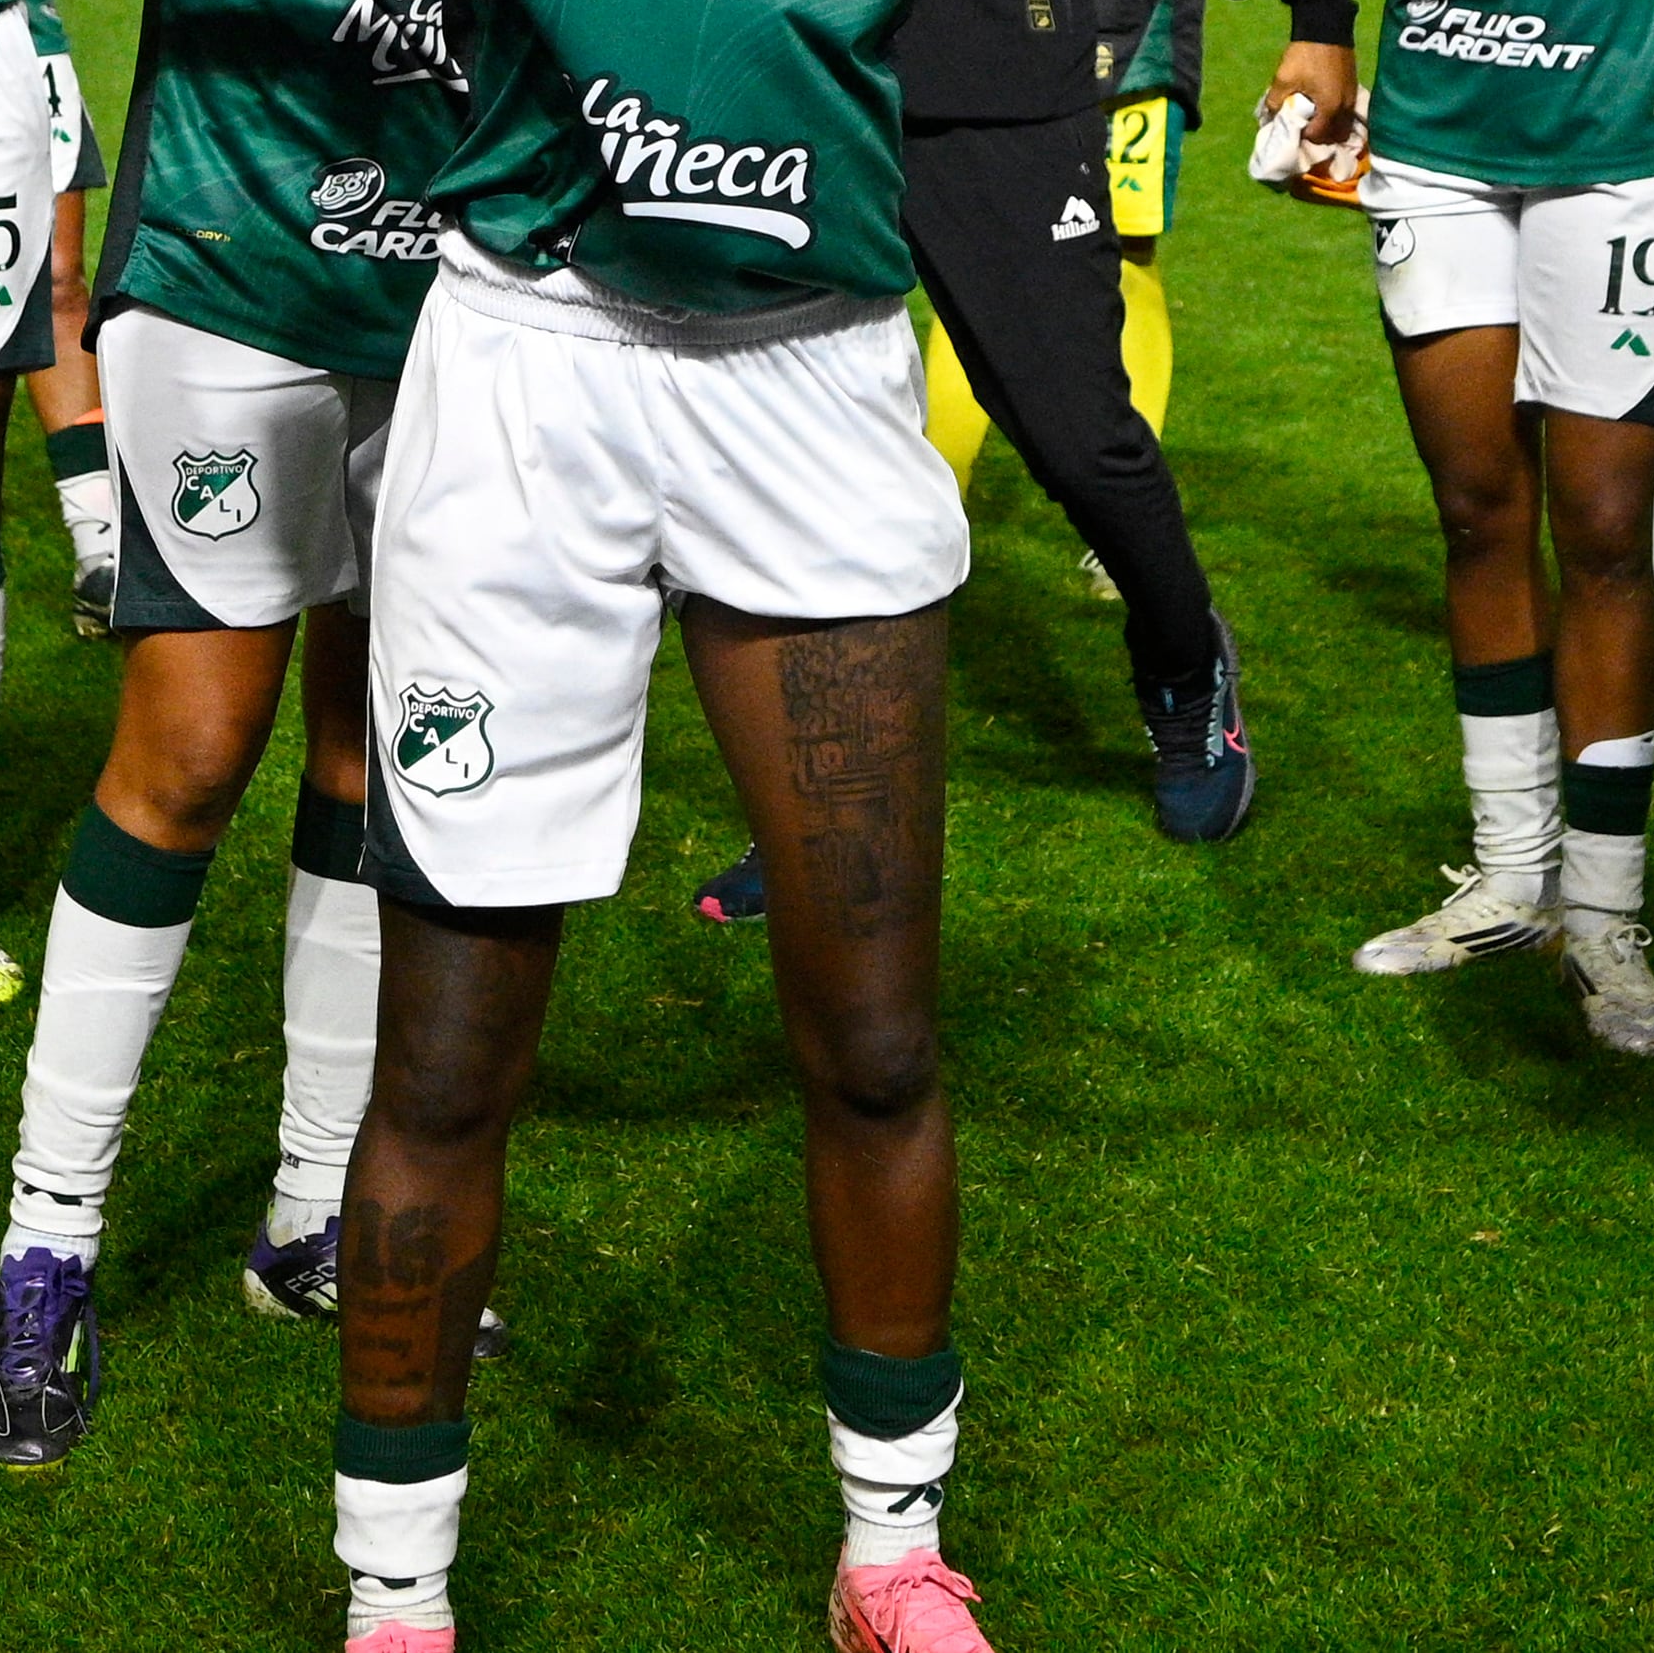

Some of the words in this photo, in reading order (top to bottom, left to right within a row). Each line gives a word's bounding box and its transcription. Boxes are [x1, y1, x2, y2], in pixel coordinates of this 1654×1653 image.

[1440, 8, 1546, 41] FLUO
[1398, 25, 1596, 70] CARDENT
[582, 79, 642, 133] La
[311, 223, 442, 260] CARD
[186, 465, 244, 476] DEPORTIVO
[410, 701, 476, 720] DEPORTIVO
[285, 1261, 337, 1294] F50
